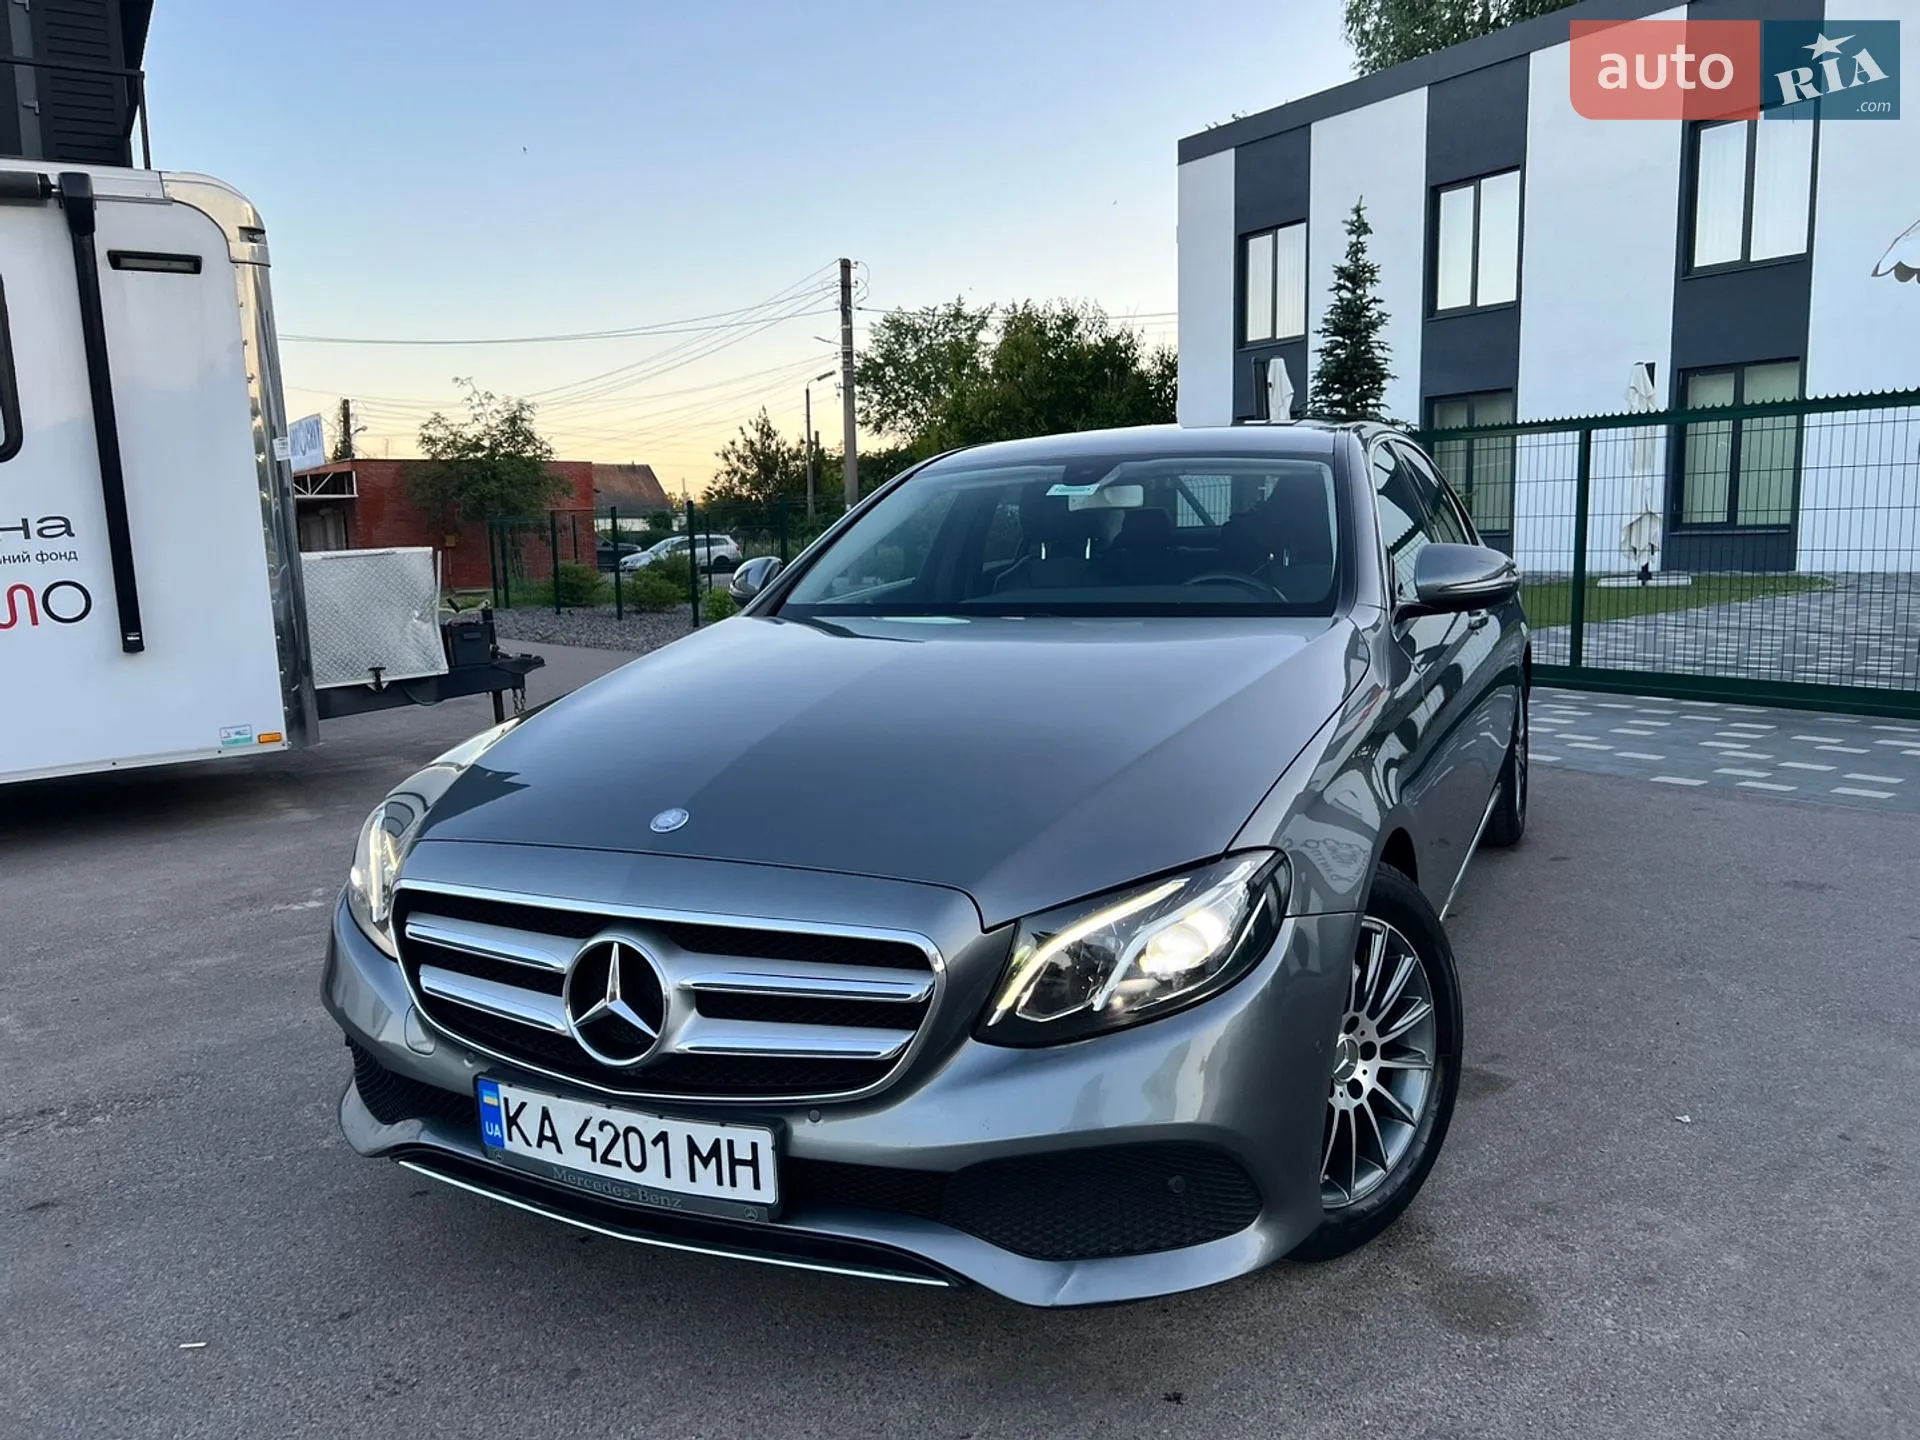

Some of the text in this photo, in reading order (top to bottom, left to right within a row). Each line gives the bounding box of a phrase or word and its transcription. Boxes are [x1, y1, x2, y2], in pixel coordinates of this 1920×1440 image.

[0, 550, 78, 565] ний фонд
[485, 1120, 502, 1139] UA
[503, 1097, 761, 1190] KA 4201 MH
[552, 1166, 682, 1209] Mercedes-Benz
